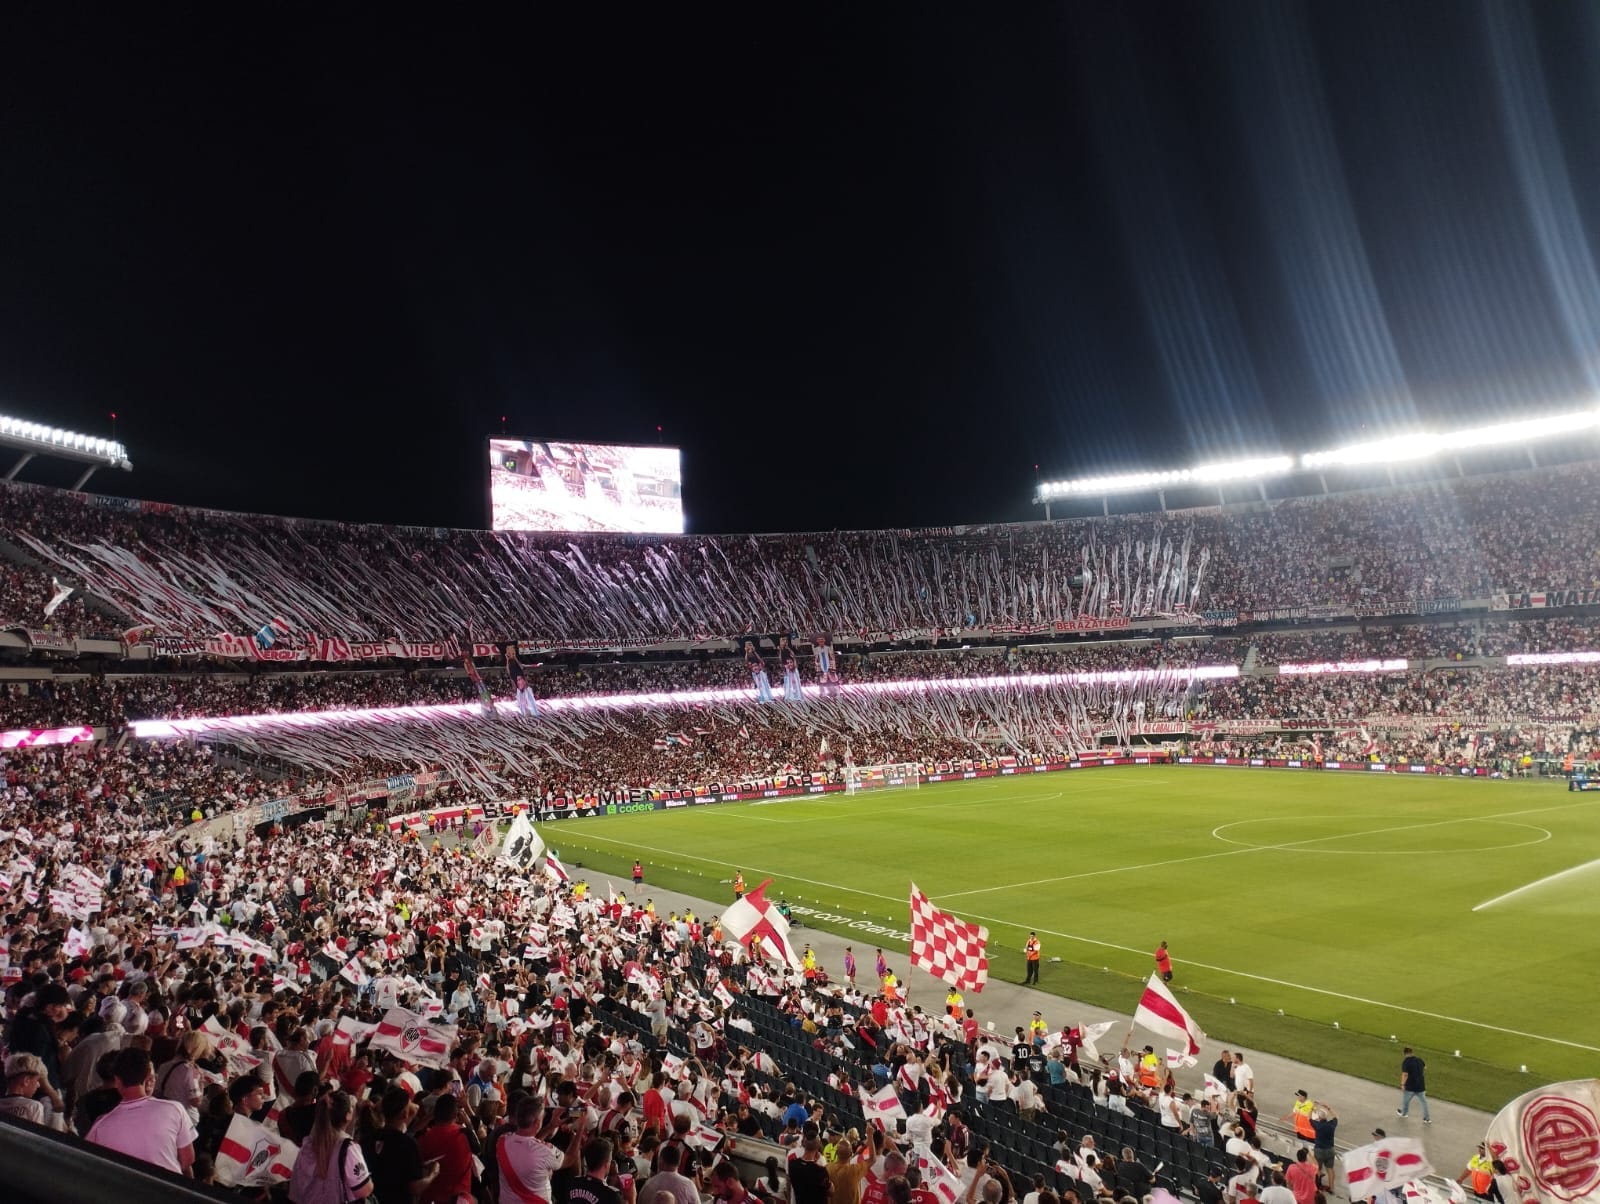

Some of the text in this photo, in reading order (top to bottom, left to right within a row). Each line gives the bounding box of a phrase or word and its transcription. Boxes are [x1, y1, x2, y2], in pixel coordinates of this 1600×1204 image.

[362, 643, 397, 657] DEL
[1280, 719, 1330, 730] LOMAS
[619, 802, 655, 813] codere
[1018, 1047, 1028, 1059] 10
